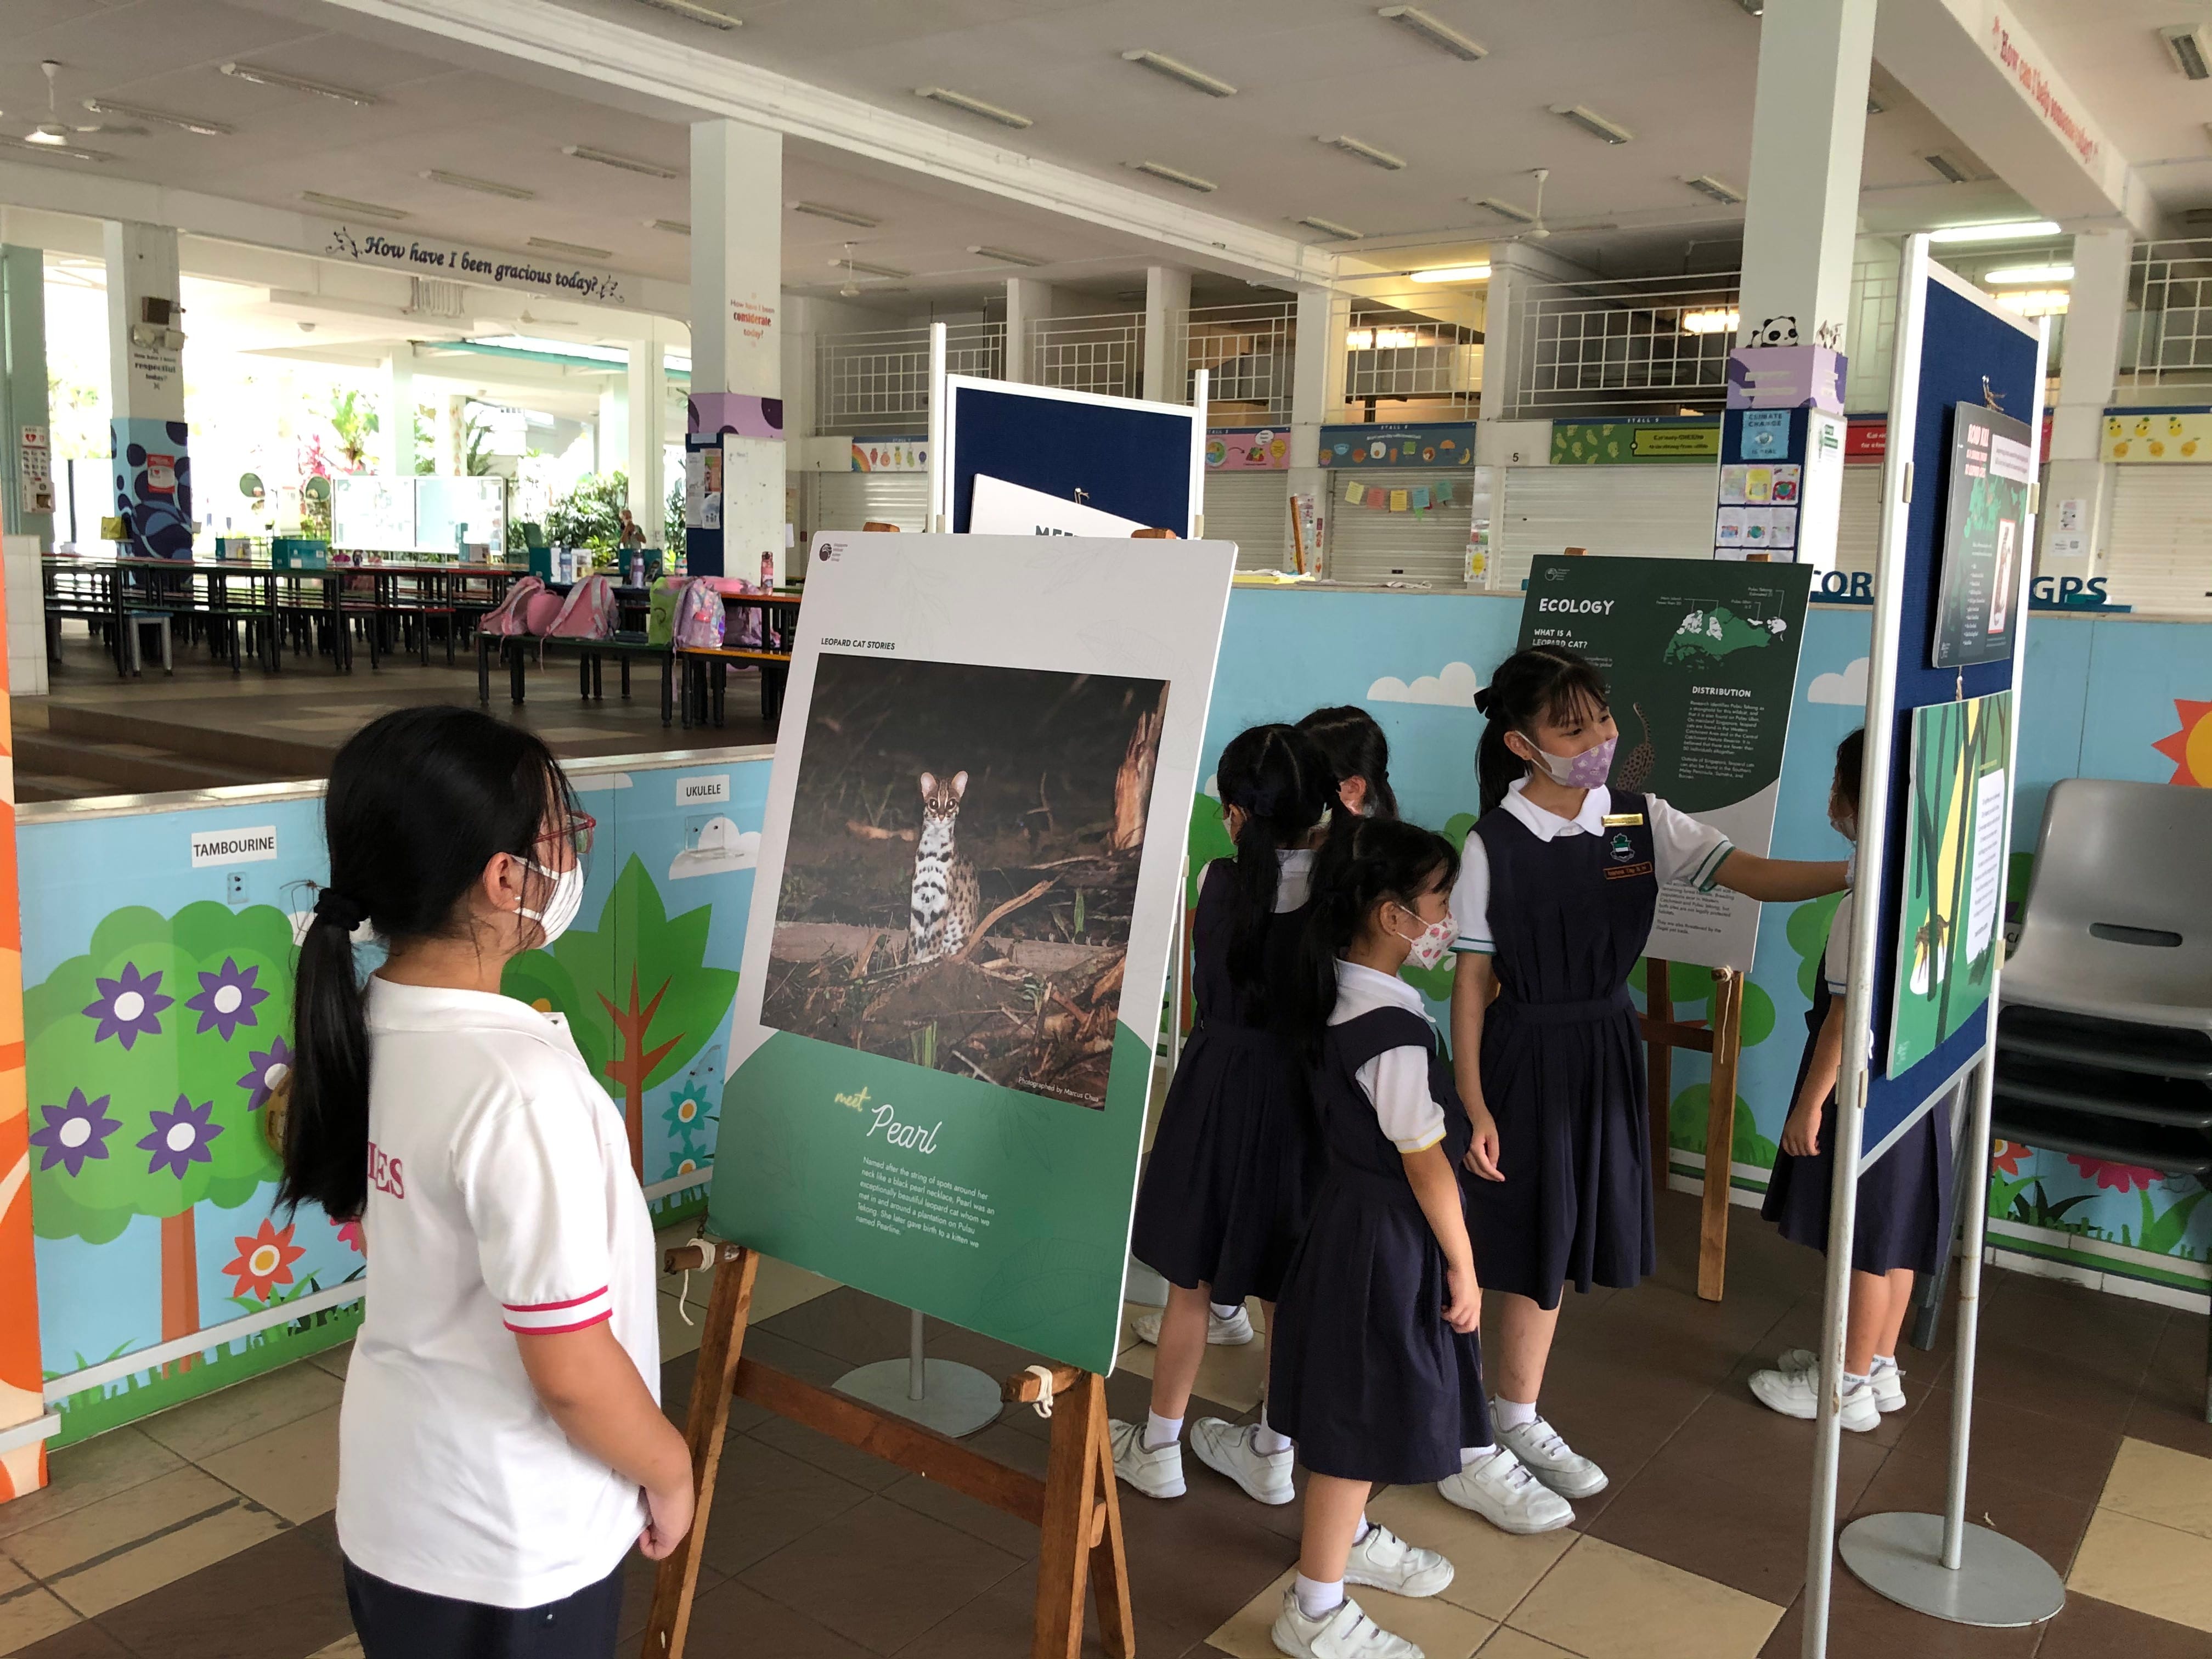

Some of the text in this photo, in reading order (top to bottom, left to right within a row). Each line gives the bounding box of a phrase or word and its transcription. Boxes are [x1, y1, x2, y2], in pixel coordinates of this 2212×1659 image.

[364, 235, 598, 296] How have I been gracious today?
[731, 299, 744, 307] How
[733, 312, 771, 326] considerate
[744, 329, 764, 340] today?
[1513, 453, 1519, 462] 5
[2030, 577, 2108, 604] GPS
[1539, 598, 1615, 615] ECOLOGY
[821, 638, 895, 650] LEOPARD CAT STORIES
[1532, 639, 1566, 647] LEOPARD
[686, 784, 721, 797] UKULELE
[194, 837, 274, 857] TAMBOURINE
[834, 1086, 872, 1112] meet
[1018, 1076, 1099, 1102] Photographed by Marcus Chua
[866, 1104, 943, 1154] Pearl
[863, 1156, 884, 1169] Named
[885, 1163, 899, 1172] after
[900, 1167, 909, 1176] the
[911, 1172, 927, 1184] string
[936, 1180, 952, 1189] spots
[954, 1188, 977, 1197] around
[978, 1189, 988, 1200] her
[860, 1181, 897, 1199] exceptionally
[898, 1190, 923, 1205] beautiful
[924, 1198, 948, 1213] leopard
[961, 1211, 979, 1222] whom
[861, 1170, 874, 1178] neck
[877, 1171, 887, 1182] like
[893, 1176, 908, 1188] black
[910, 1184, 926, 1193] pearl
[927, 1190, 954, 1204] necklace,
[956, 1197, 972, 1207] Pearl
[973, 1203, 985, 1212] was
[856, 1216, 901, 1235] named Pearline.
[881, 1210, 891, 1220] She
[893, 1213, 906, 1224] later
[907, 1220, 922, 1228] gave
[923, 1223, 936, 1234] birth
[939, 1229, 944, 1238] to
[952, 1232, 968, 1244] kitten
[890, 1203, 911, 1214] around
[917, 1210, 946, 1224] plantation
[958, 1222, 975, 1234] Pulau
